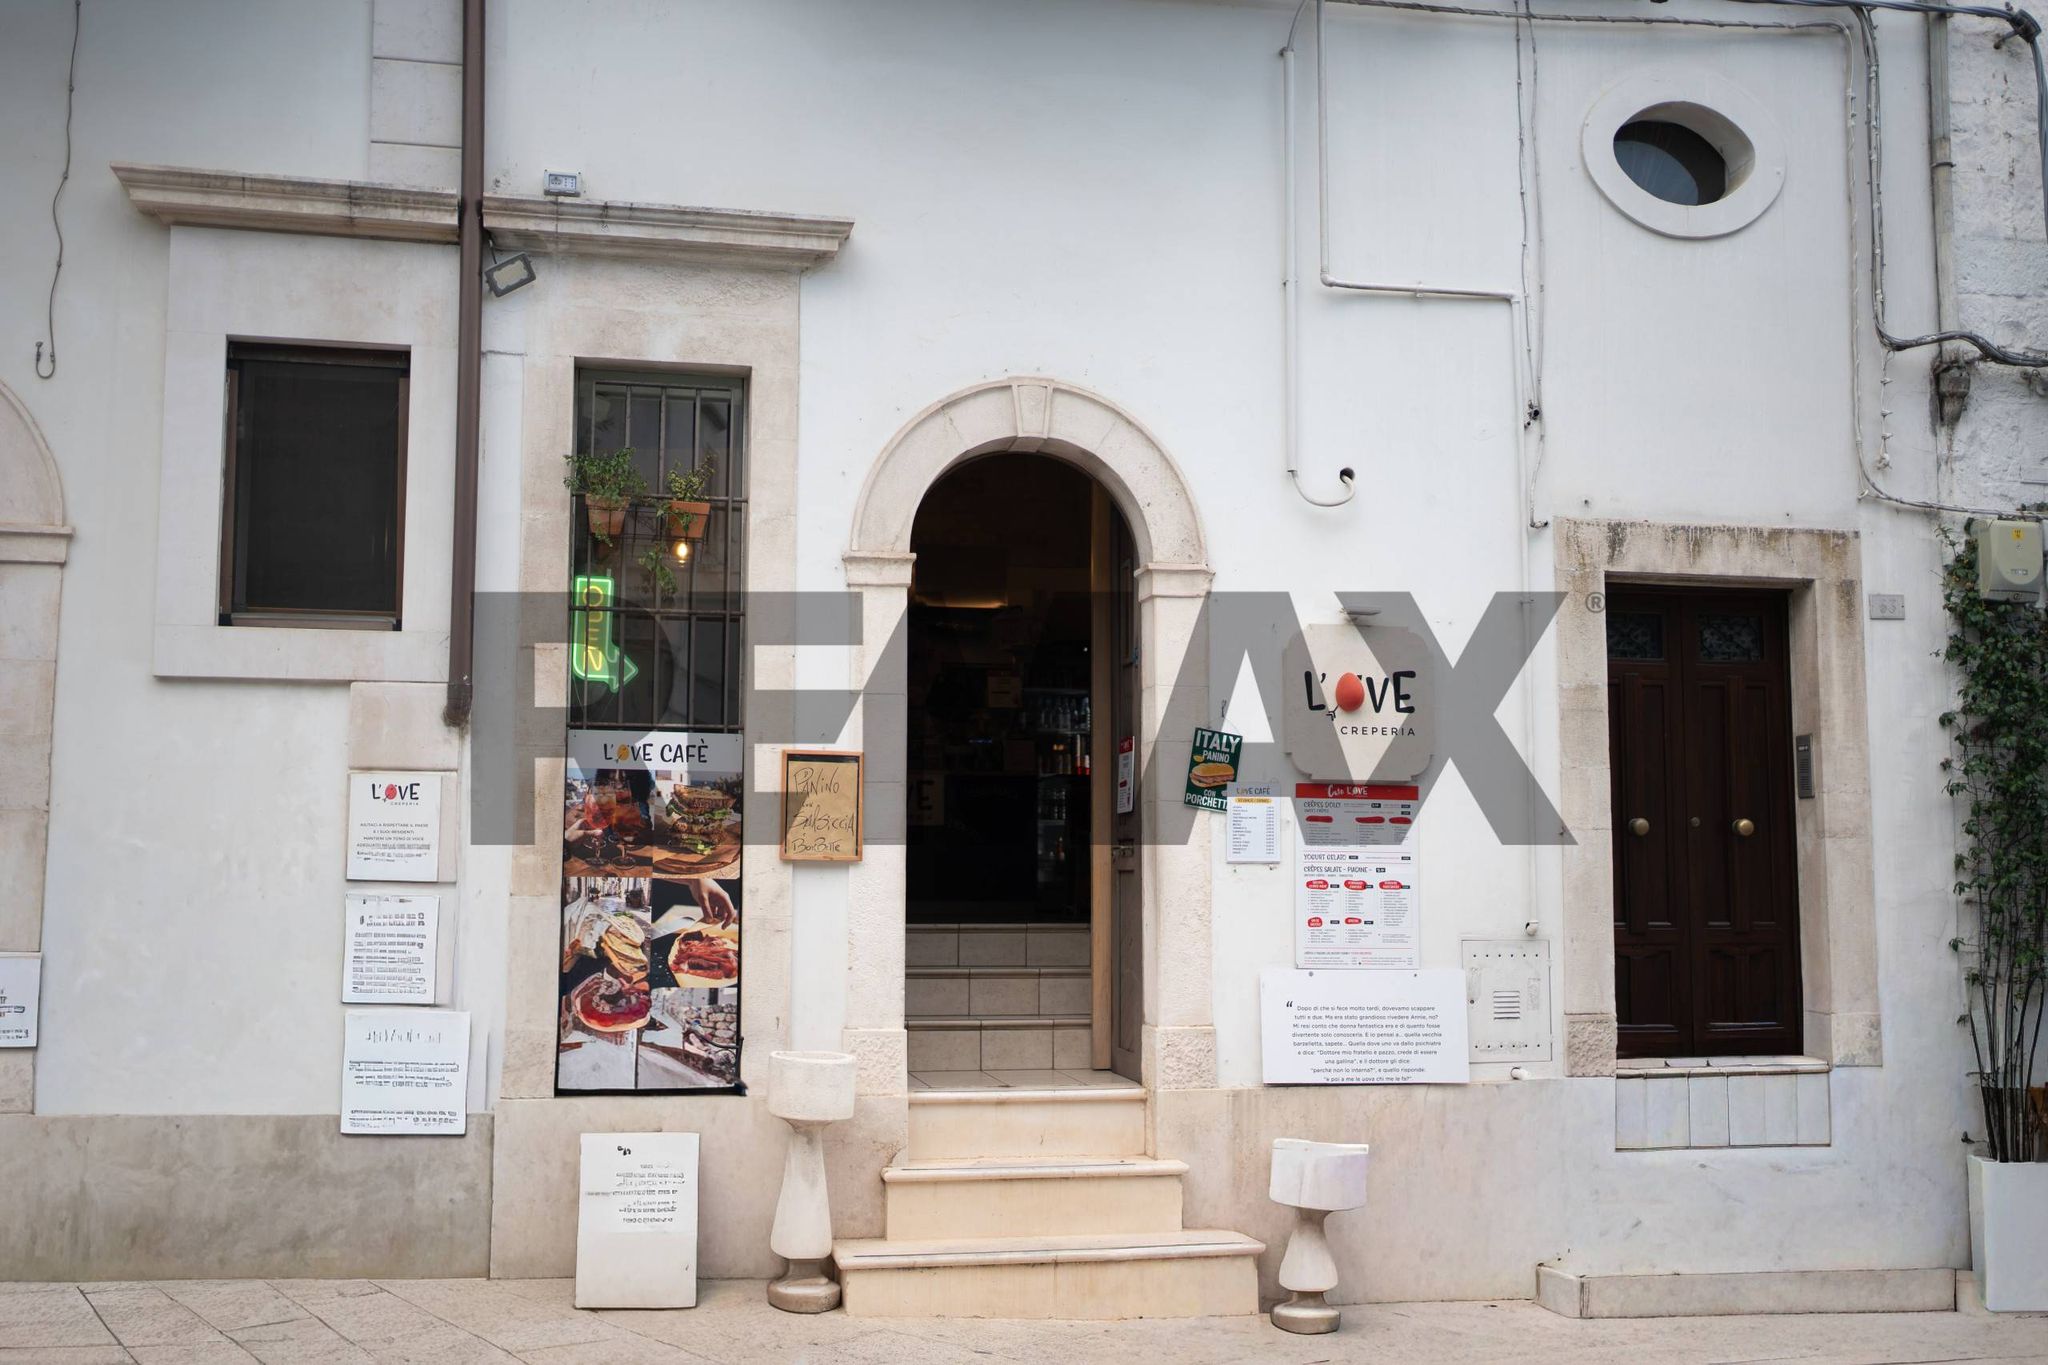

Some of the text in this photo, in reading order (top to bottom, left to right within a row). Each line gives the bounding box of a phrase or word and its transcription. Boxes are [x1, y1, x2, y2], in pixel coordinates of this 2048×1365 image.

[1340, 726, 1415, 736] CREPERIA
[1195, 730, 1240, 753] ITALY
[660, 738, 708, 763] CAFÈ
[1202, 750, 1230, 763] PANINO
[1203, 789, 1216, 797] CON
[1185, 793, 1228, 810] PORCHETT
